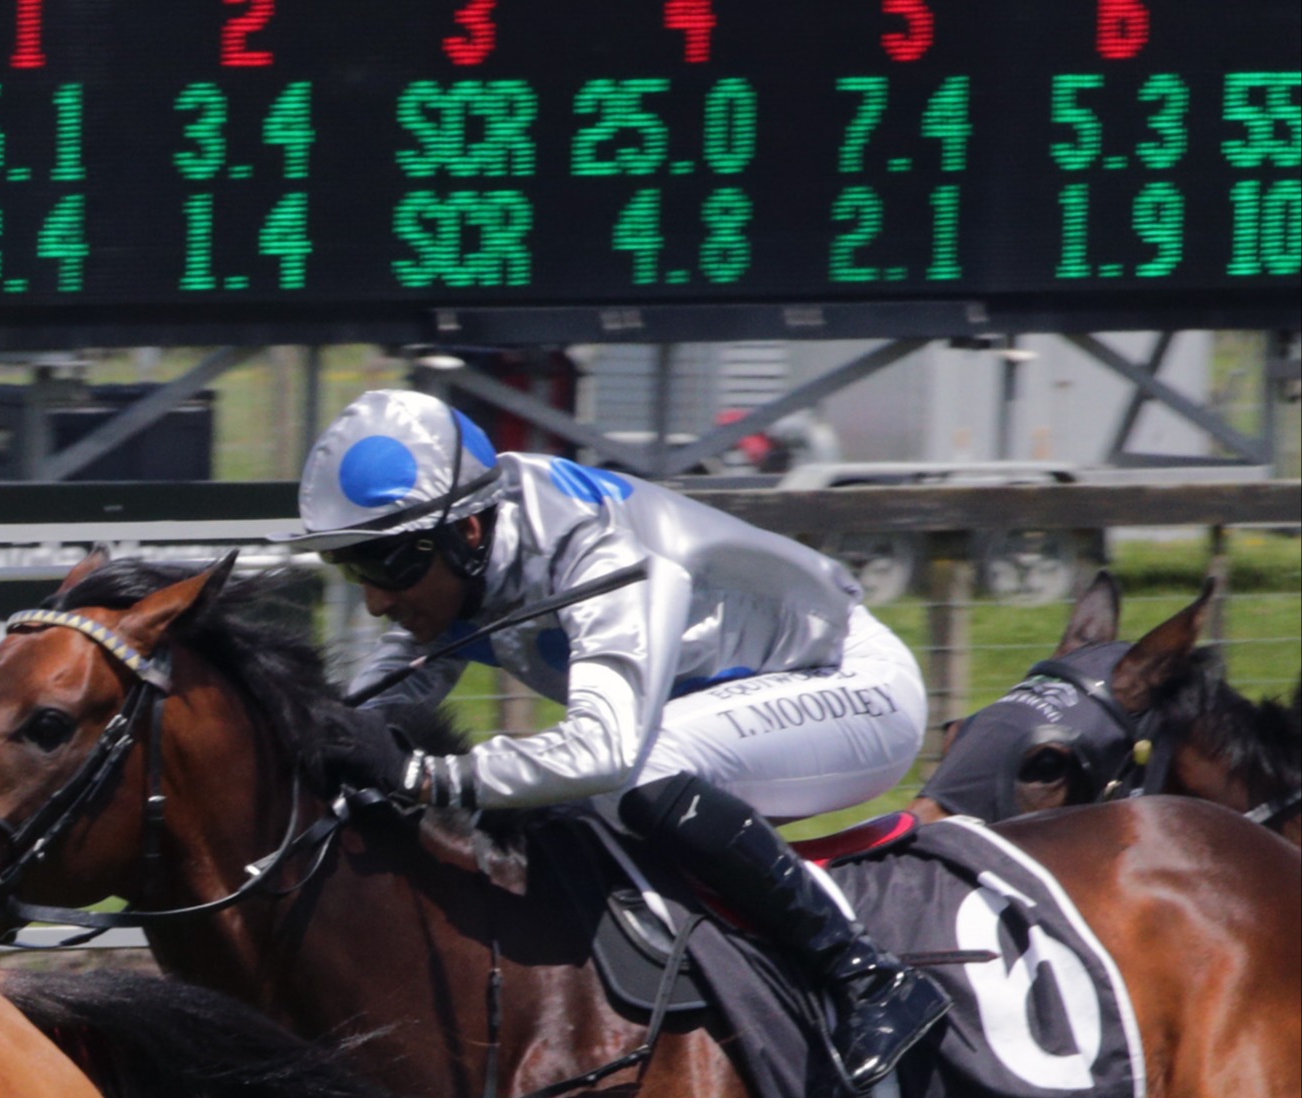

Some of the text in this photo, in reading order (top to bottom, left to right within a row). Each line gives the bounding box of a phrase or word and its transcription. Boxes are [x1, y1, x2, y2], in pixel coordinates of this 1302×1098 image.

[11, 0, 45, 68] 1
[222, 0, 274, 67] 2
[444, 0, 496, 65] 3
[666, 0, 716, 63] 4
[1098, 0, 1149, 59] 6
[175, 82, 315, 179] 3.4
[397, 81, 538, 177] SCR
[571, 79, 757, 176] 25.0
[837, 76, 972, 172] 7.4
[1051, 74, 1190, 170] 5.3
[180, 193, 313, 290] 1.4
[393, 191, 533, 287] SCR
[613, 188, 753, 284] 4.8
[830, 186, 961, 281] 2.1
[1056, 183, 1185, 278] 1.9
